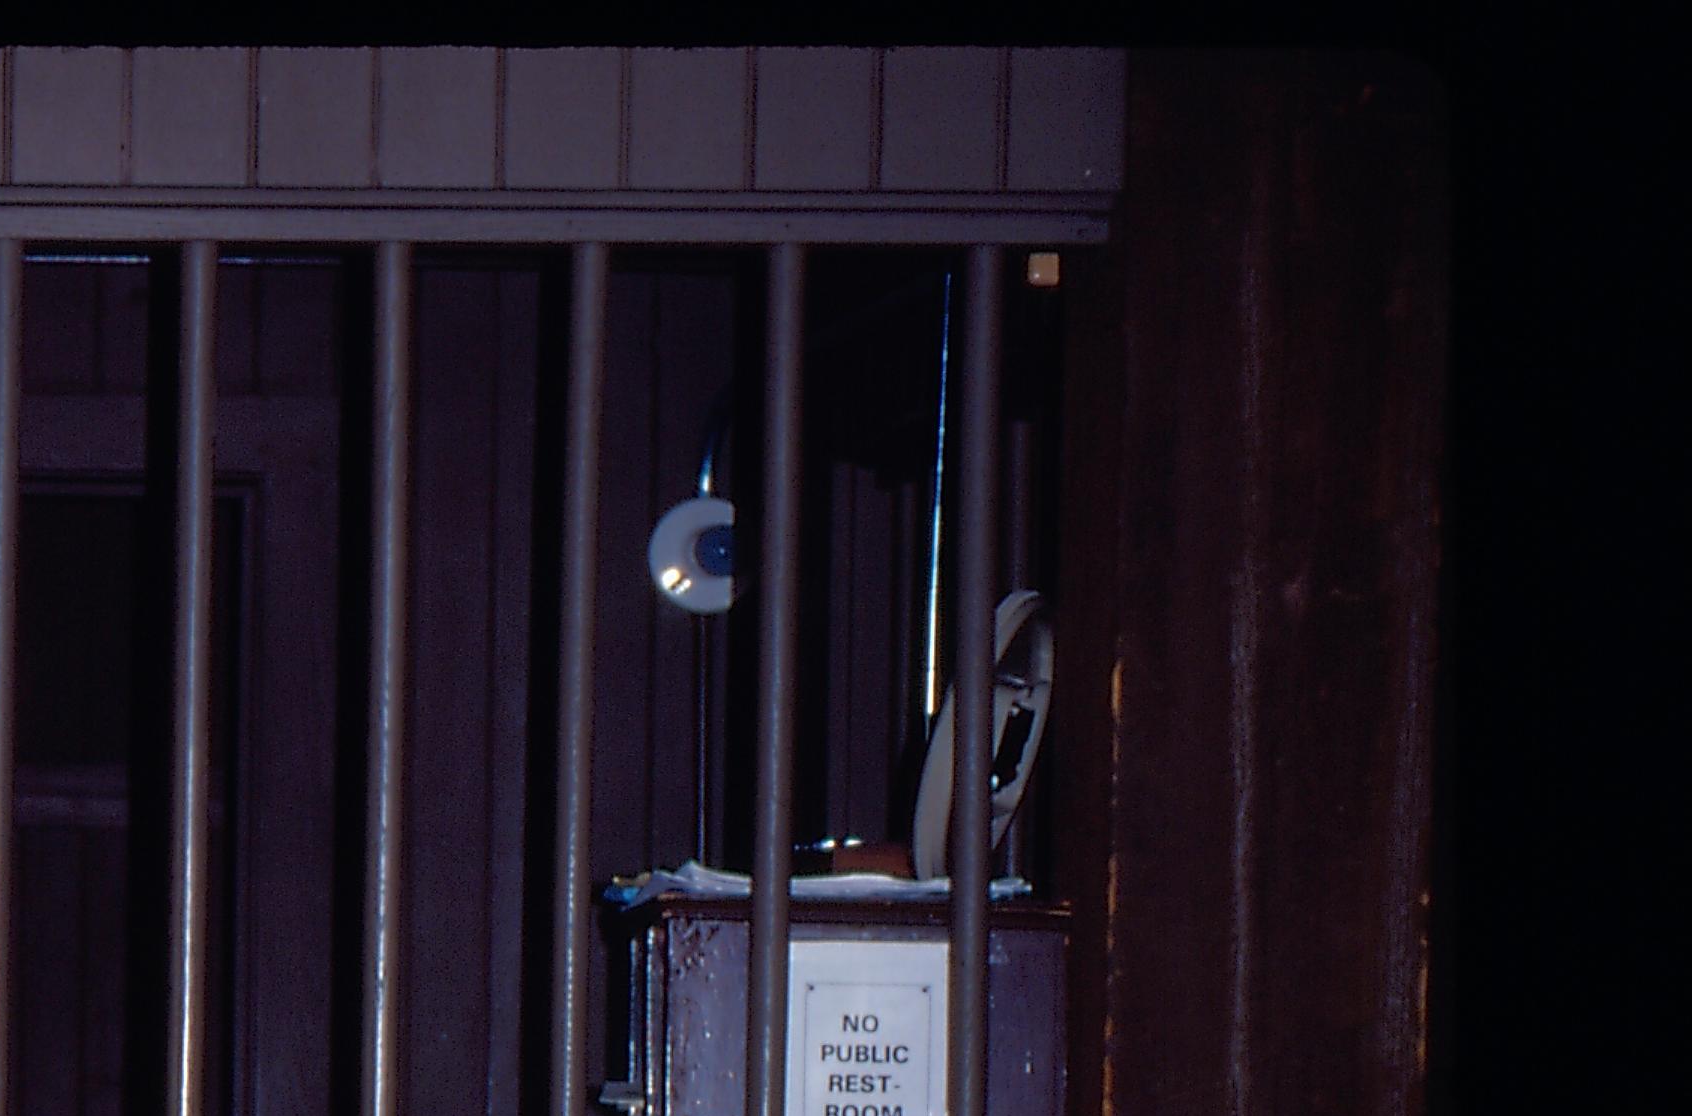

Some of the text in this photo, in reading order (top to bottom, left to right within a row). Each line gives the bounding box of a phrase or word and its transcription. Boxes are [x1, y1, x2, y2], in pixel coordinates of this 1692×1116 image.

[842, 1014, 879, 1033] NO
[820, 1044, 909, 1064] PUBLIC
[828, 1074, 901, 1093] REST-
